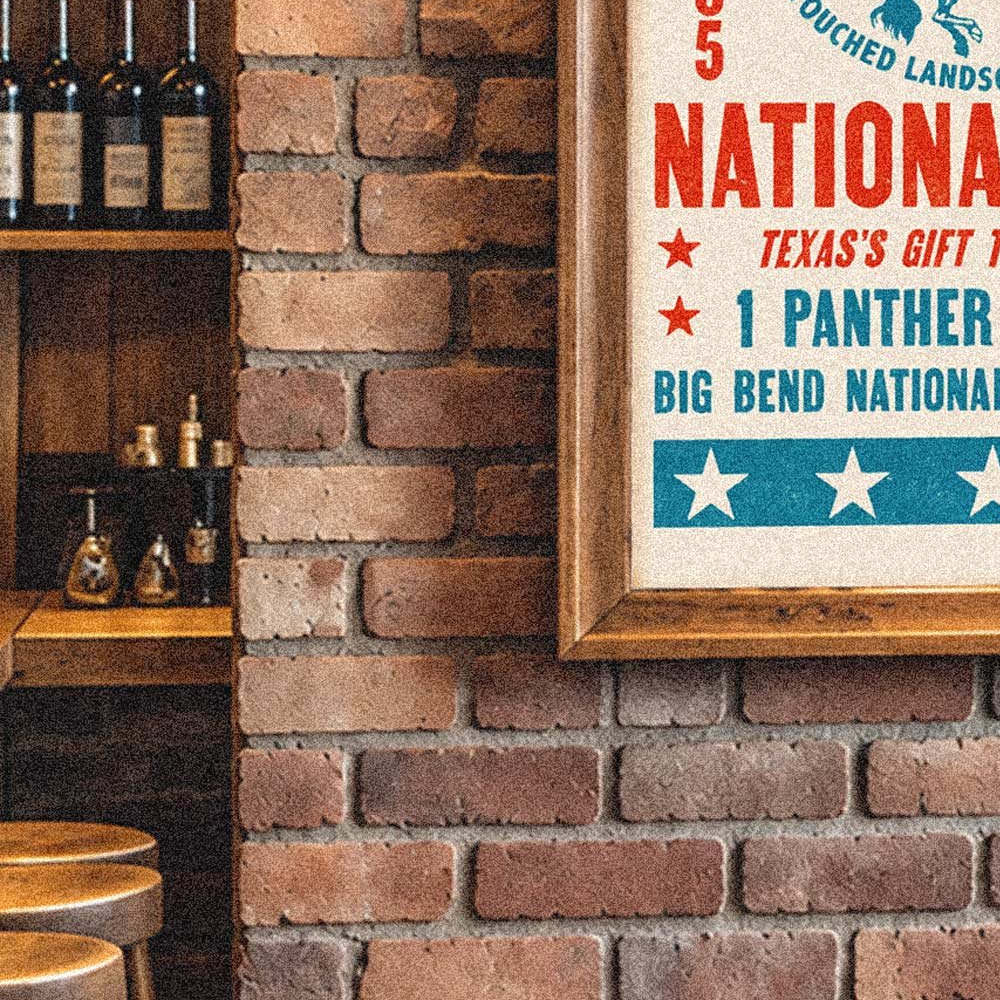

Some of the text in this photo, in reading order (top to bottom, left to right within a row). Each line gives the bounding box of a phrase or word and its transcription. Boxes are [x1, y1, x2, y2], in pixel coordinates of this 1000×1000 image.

[901, 227, 976, 269] GIFT
[736, 290, 752, 347] 1
[784, 289, 992, 347] PANTHER
[654, 370, 711, 413] BIG
[734, 370, 824, 412] BEND
